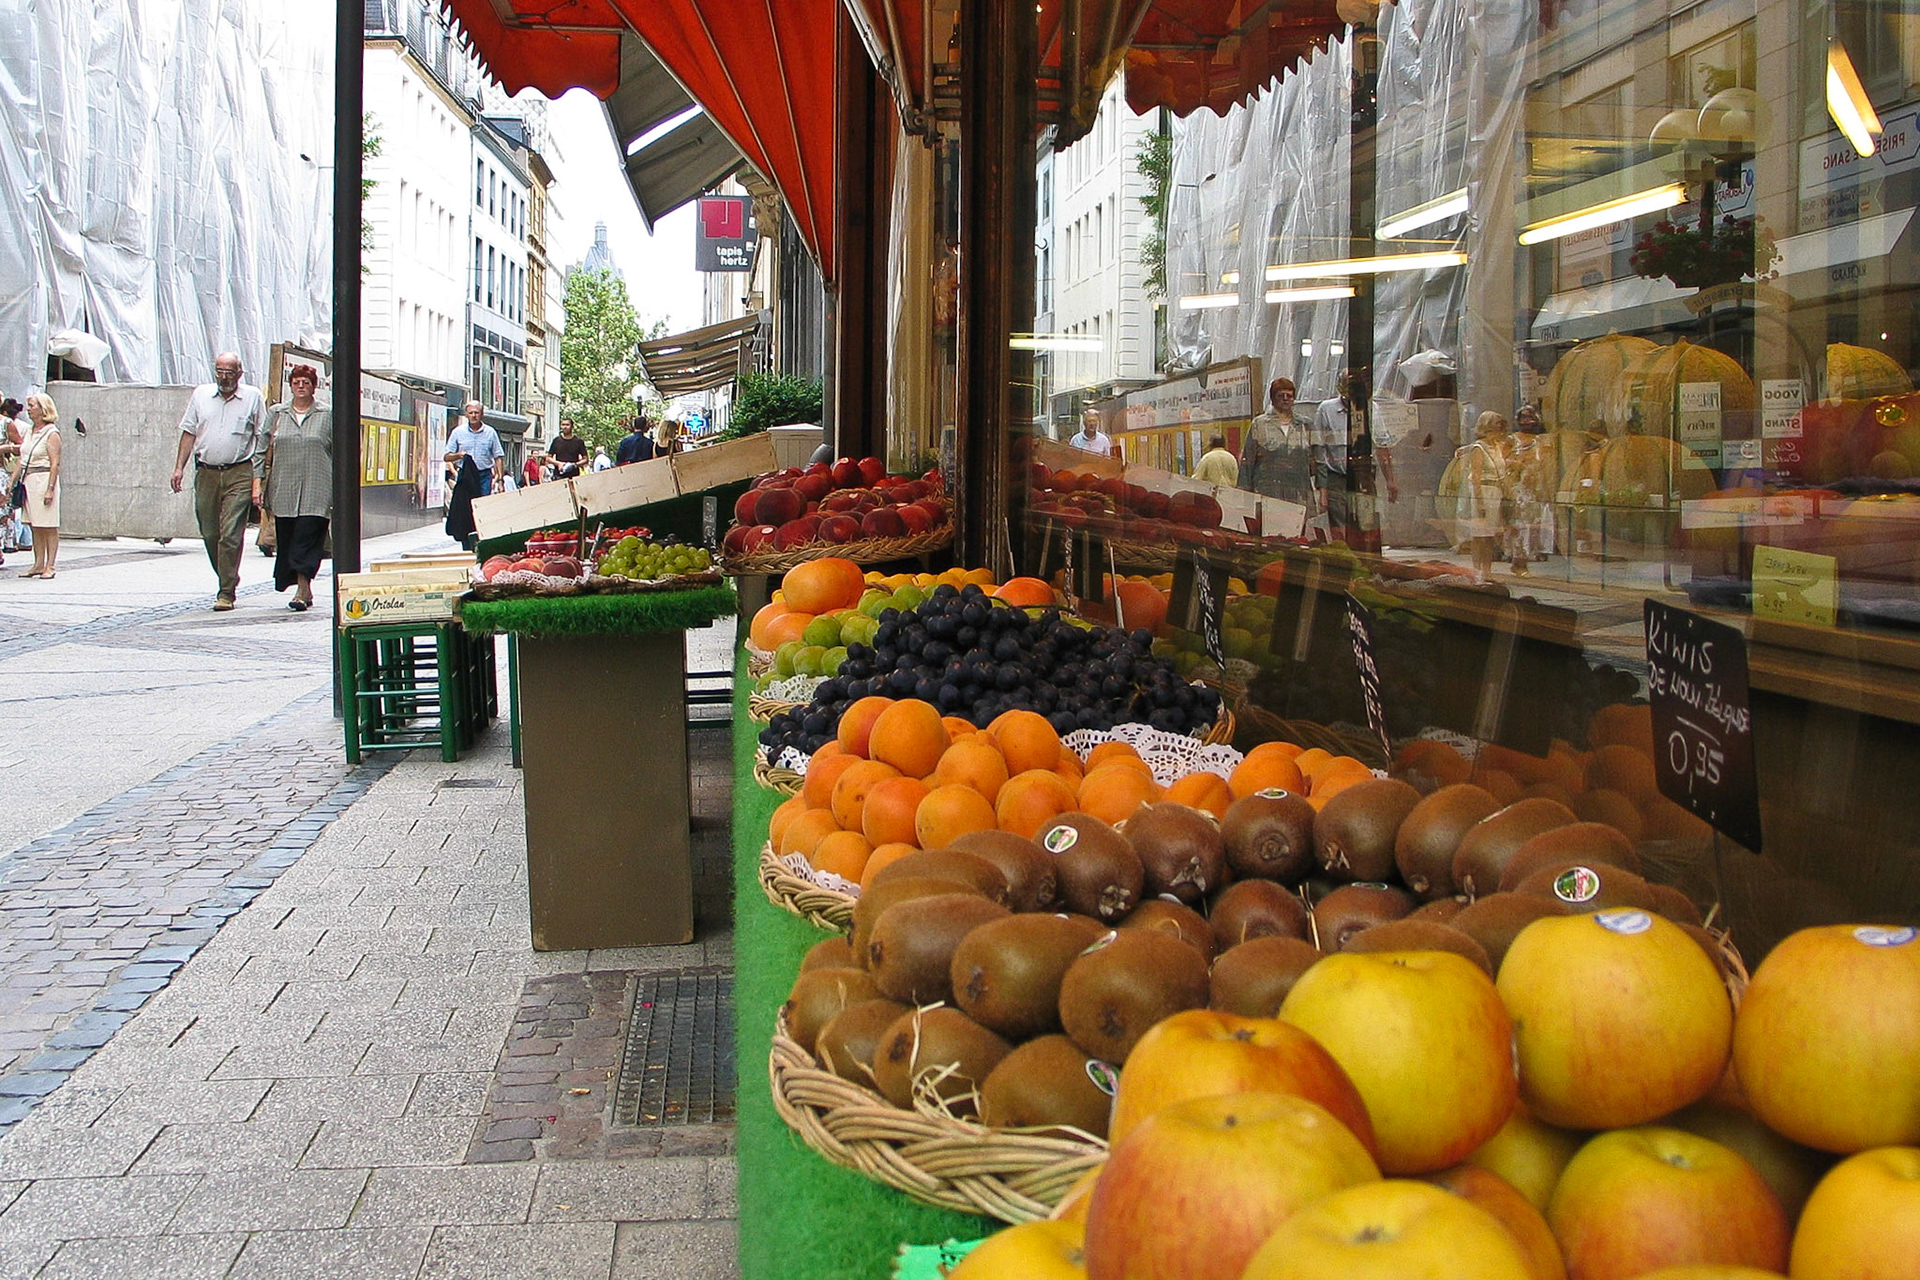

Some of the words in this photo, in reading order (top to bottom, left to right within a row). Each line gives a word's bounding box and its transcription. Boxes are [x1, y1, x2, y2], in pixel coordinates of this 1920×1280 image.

[716, 246, 743, 257] tapis
[721, 257, 748, 265] hertz
[372, 597, 405, 610] Ortolan
[1648, 661, 1666, 695] DE
[1668, 731, 1724, 794] 0,95
